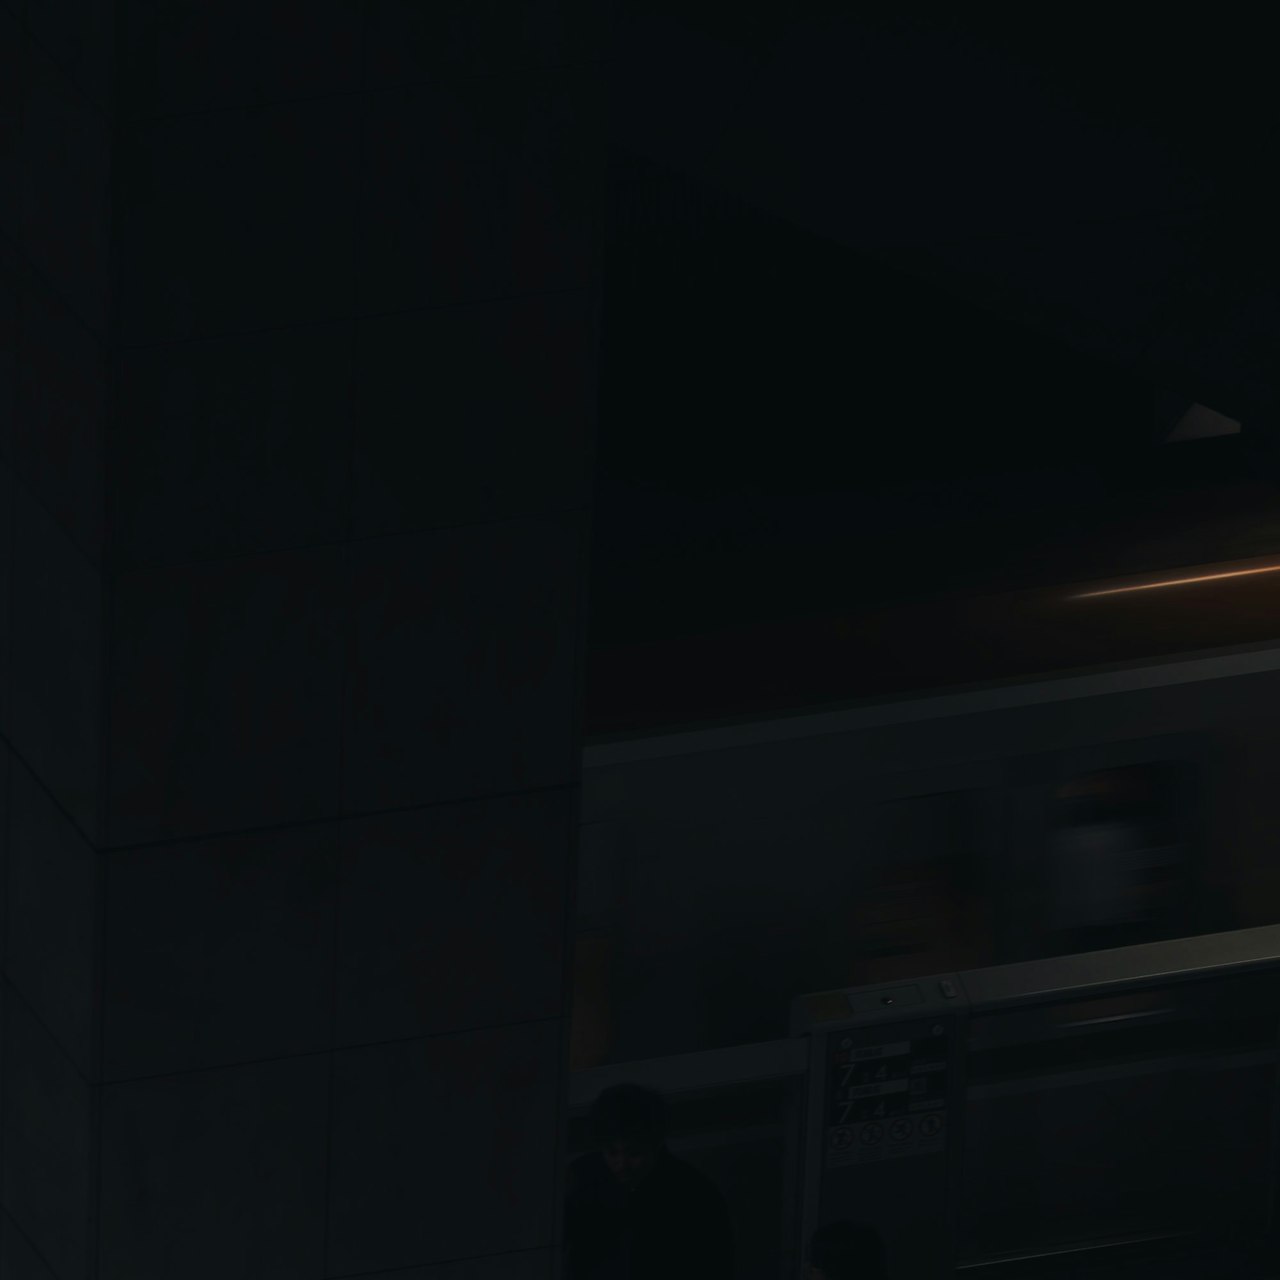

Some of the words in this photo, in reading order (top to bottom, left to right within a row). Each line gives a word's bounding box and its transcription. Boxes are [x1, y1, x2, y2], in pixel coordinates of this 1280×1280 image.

[840, 1063, 856, 1087] 7
[875, 1063, 888, 1080] 4
[838, 1101, 856, 1123] 7
[873, 1101, 886, 1117] 4
